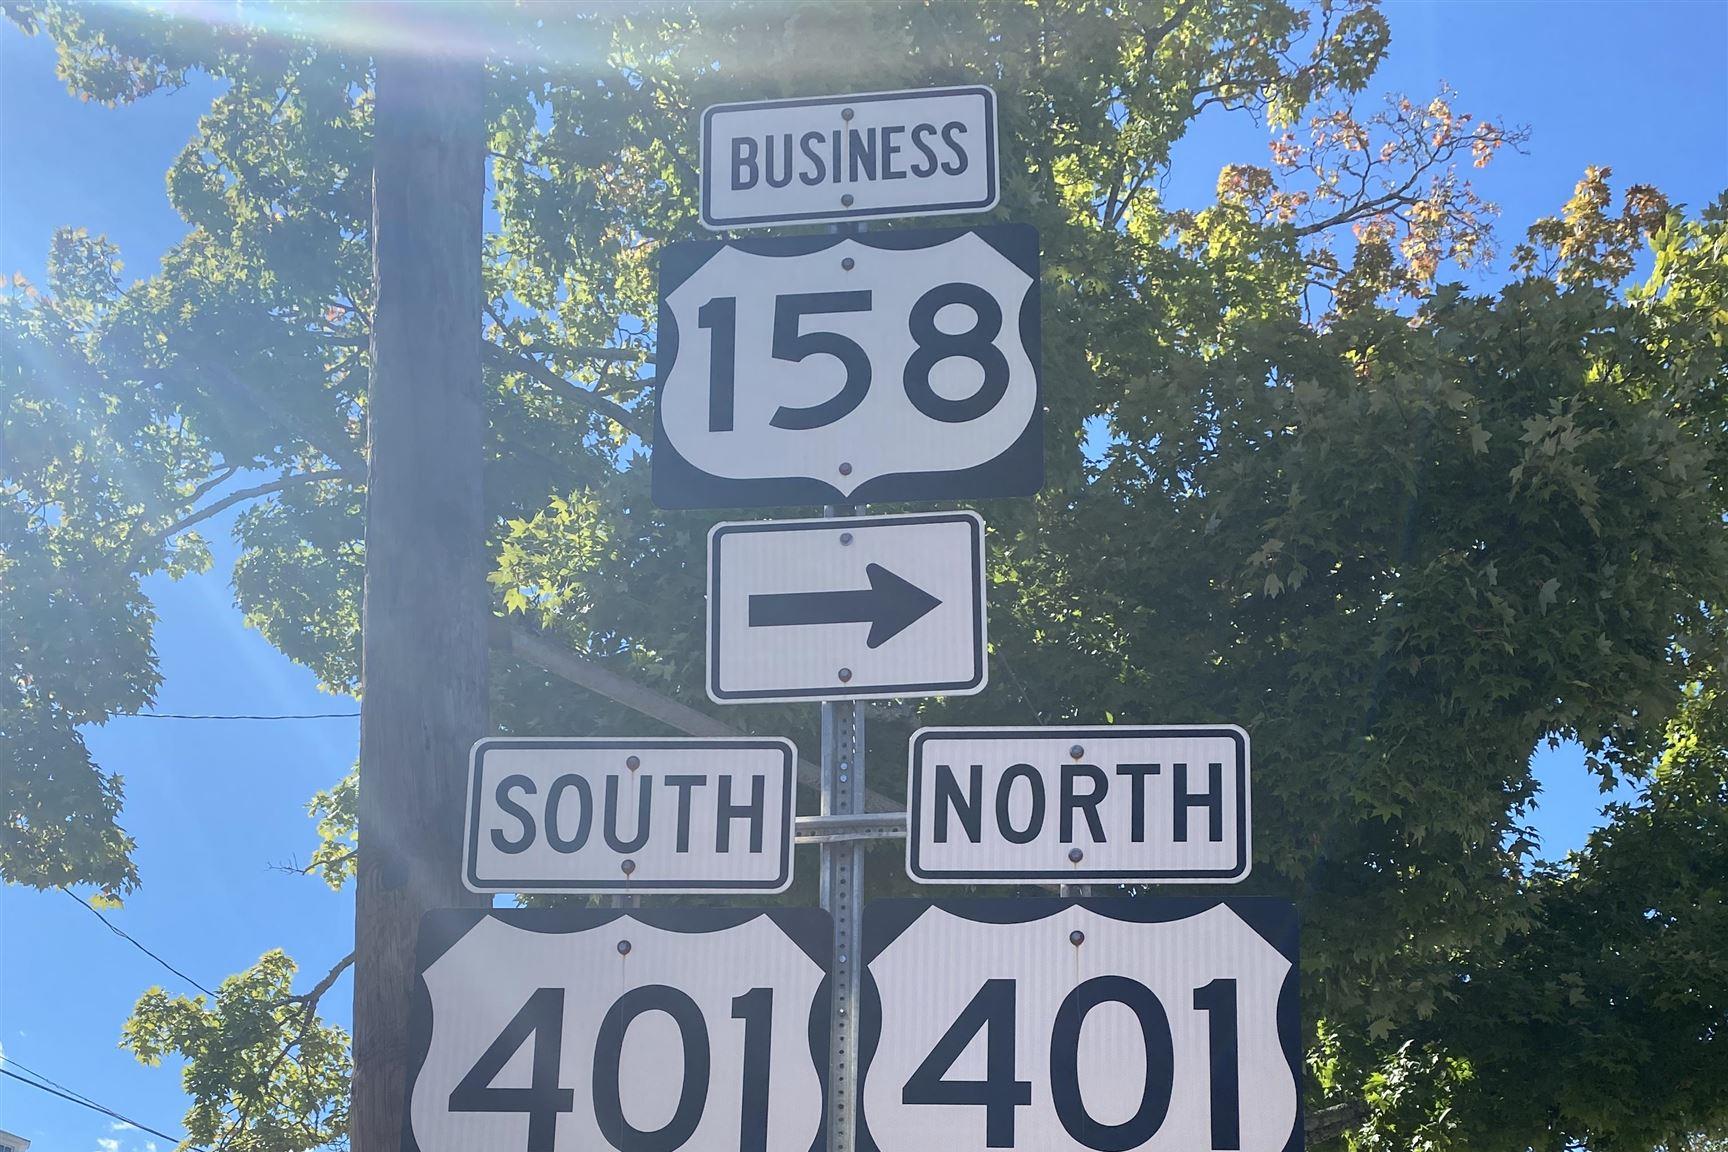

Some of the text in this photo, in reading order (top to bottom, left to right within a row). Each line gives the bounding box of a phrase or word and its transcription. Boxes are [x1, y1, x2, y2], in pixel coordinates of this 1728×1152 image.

[730, 121, 969, 191] BUSINESS
[697, 281, 1011, 432] 158
[489, 773, 766, 855] SOUTH
[932, 763, 1224, 845] NORTH
[901, 975, 1241, 1152] 401
